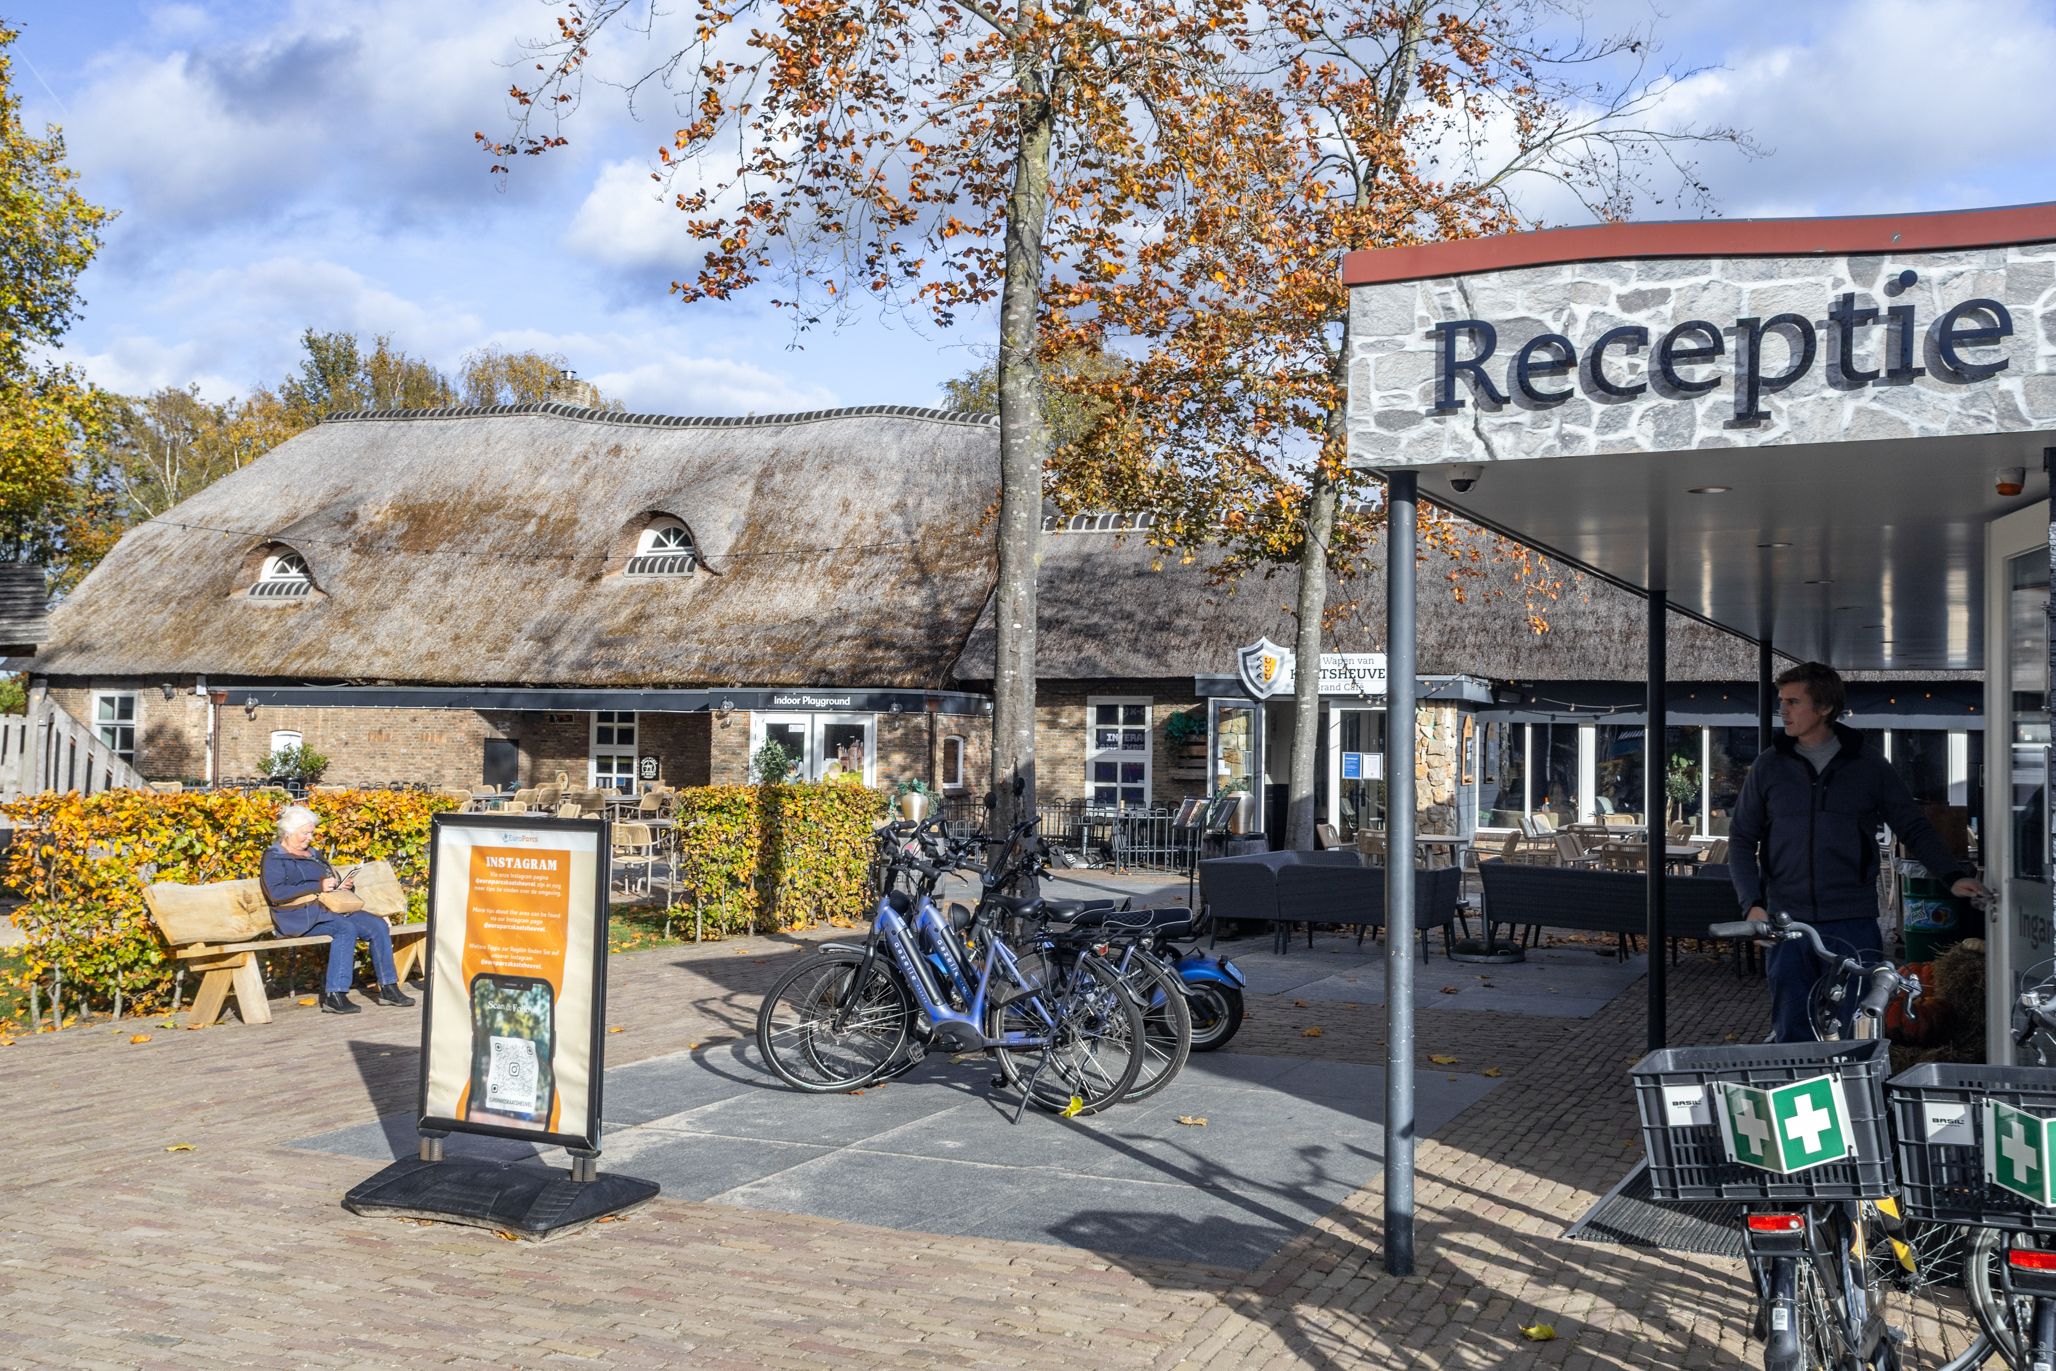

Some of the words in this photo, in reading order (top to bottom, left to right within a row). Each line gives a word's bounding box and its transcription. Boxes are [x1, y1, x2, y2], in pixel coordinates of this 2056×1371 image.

[1434, 269, 2014, 421] Receptie
[1322, 657, 1355, 666] Wapen
[1319, 683, 1341, 691] rand
[774, 695, 801, 705] Indoor
[802, 695, 851, 707] Playground
[485, 856, 557, 871] INSTAGRAM
[487, 1000, 505, 1010] Scan
[505, 1003, 512, 1011] &
